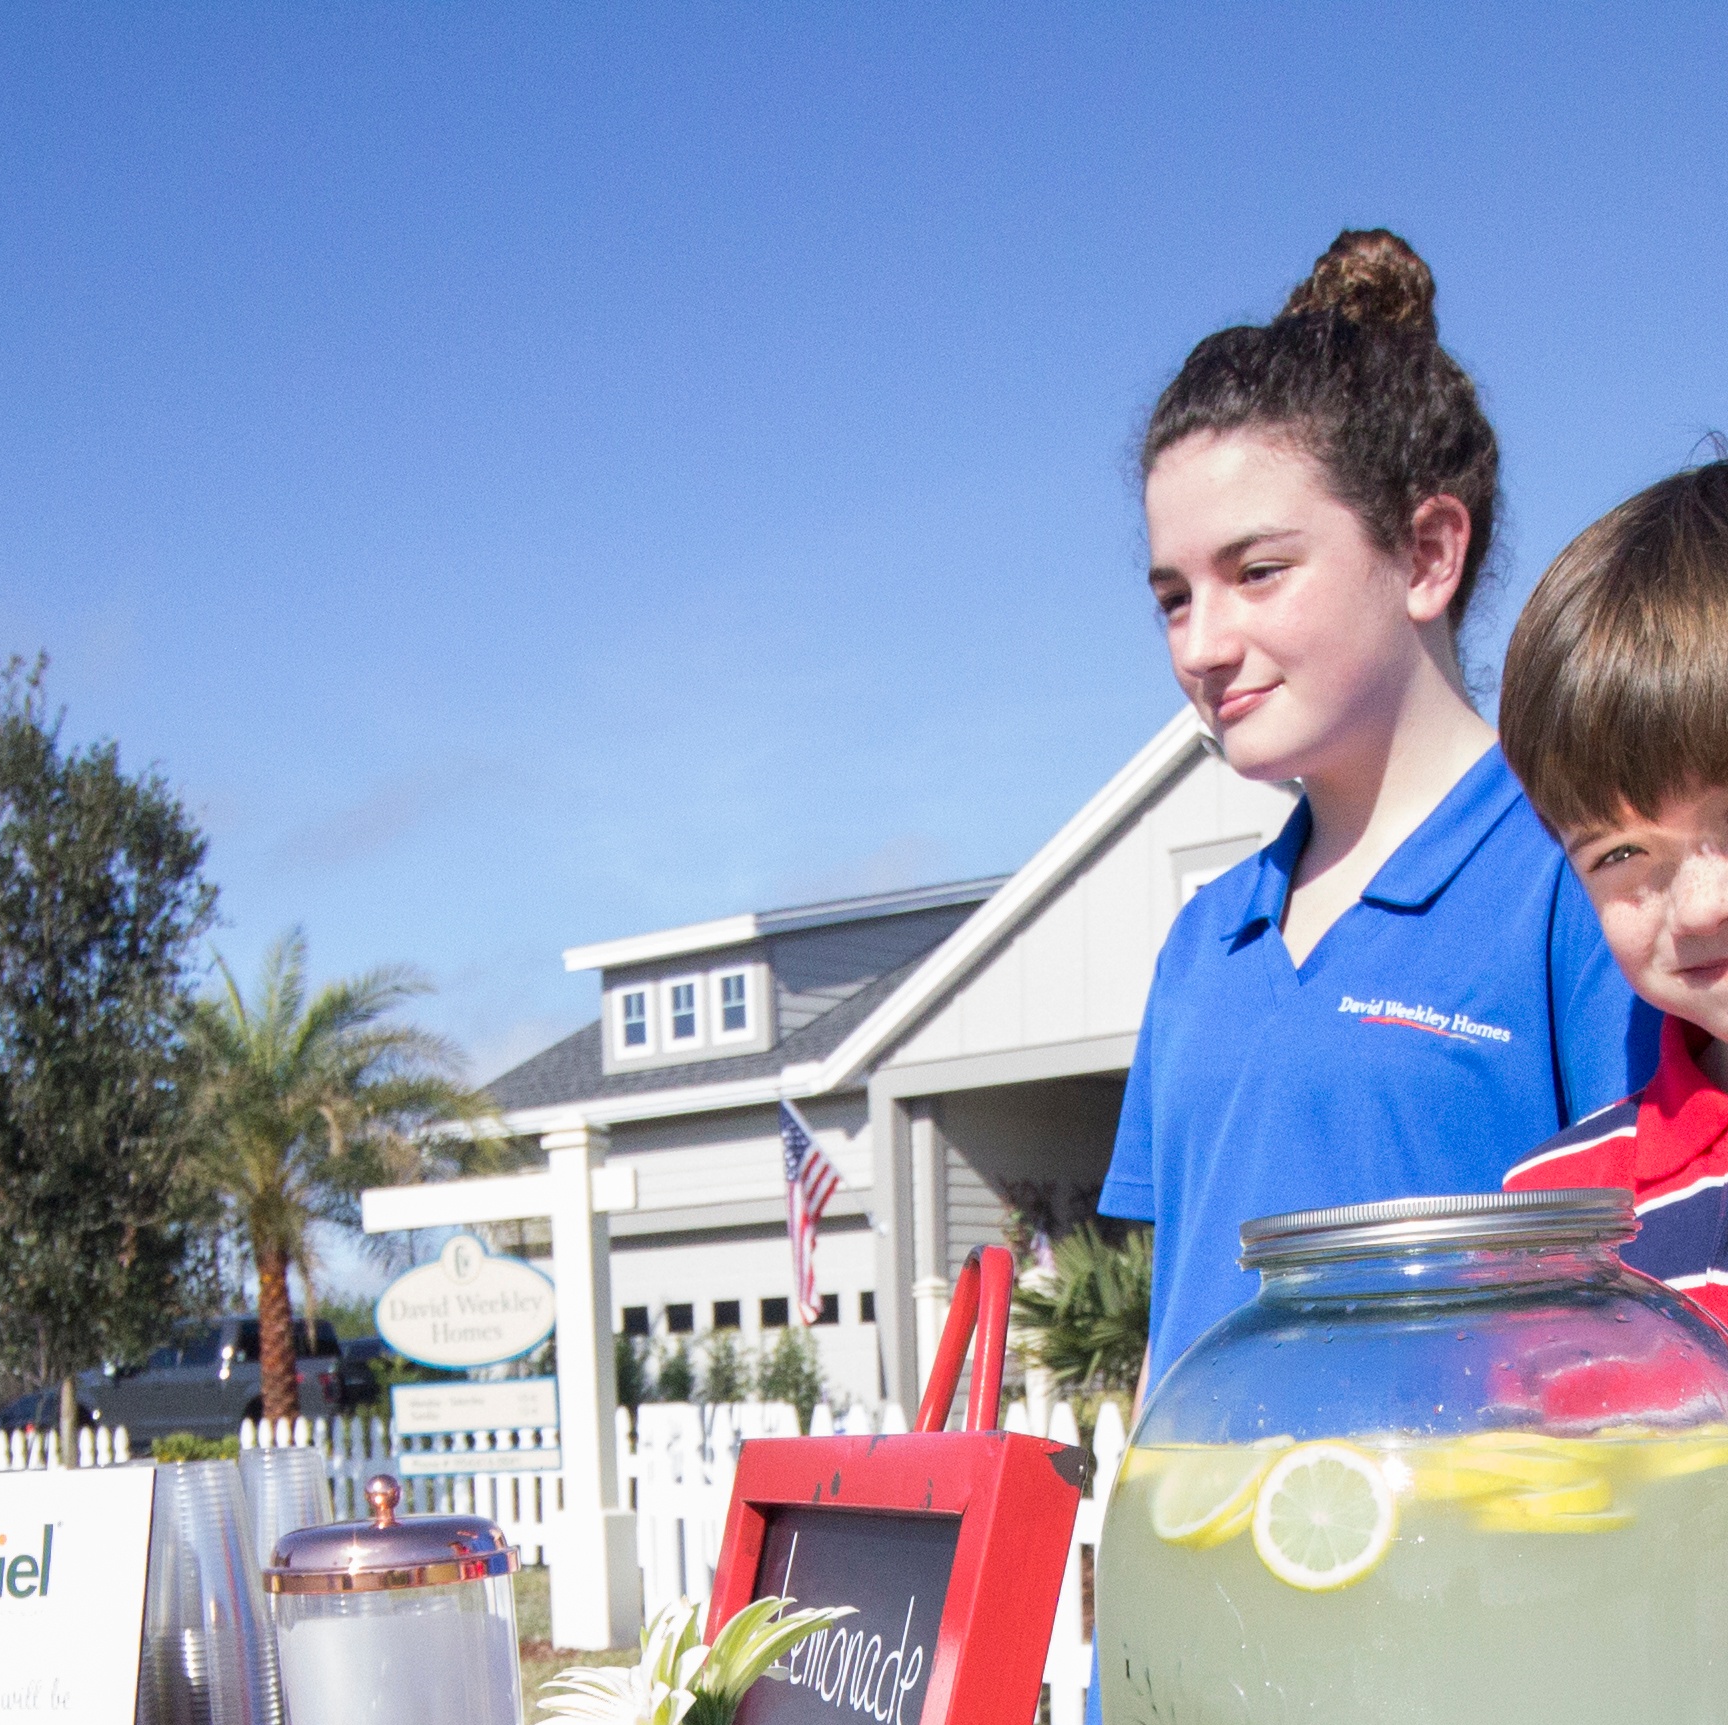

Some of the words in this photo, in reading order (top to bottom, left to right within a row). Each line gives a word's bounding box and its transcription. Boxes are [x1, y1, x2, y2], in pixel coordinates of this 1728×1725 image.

[1338, 996, 1384, 1016] David
[1384, 1000, 1451, 1030] Weekley
[1451, 1013, 1512, 1042] Homes
[389, 1295, 449, 1321] David
[456, 1289, 543, 1319] Weekley
[431, 1322, 503, 1345] Homes
[1, 1678, 43, 1711] will
[50, 1677, 71, 1711] be
